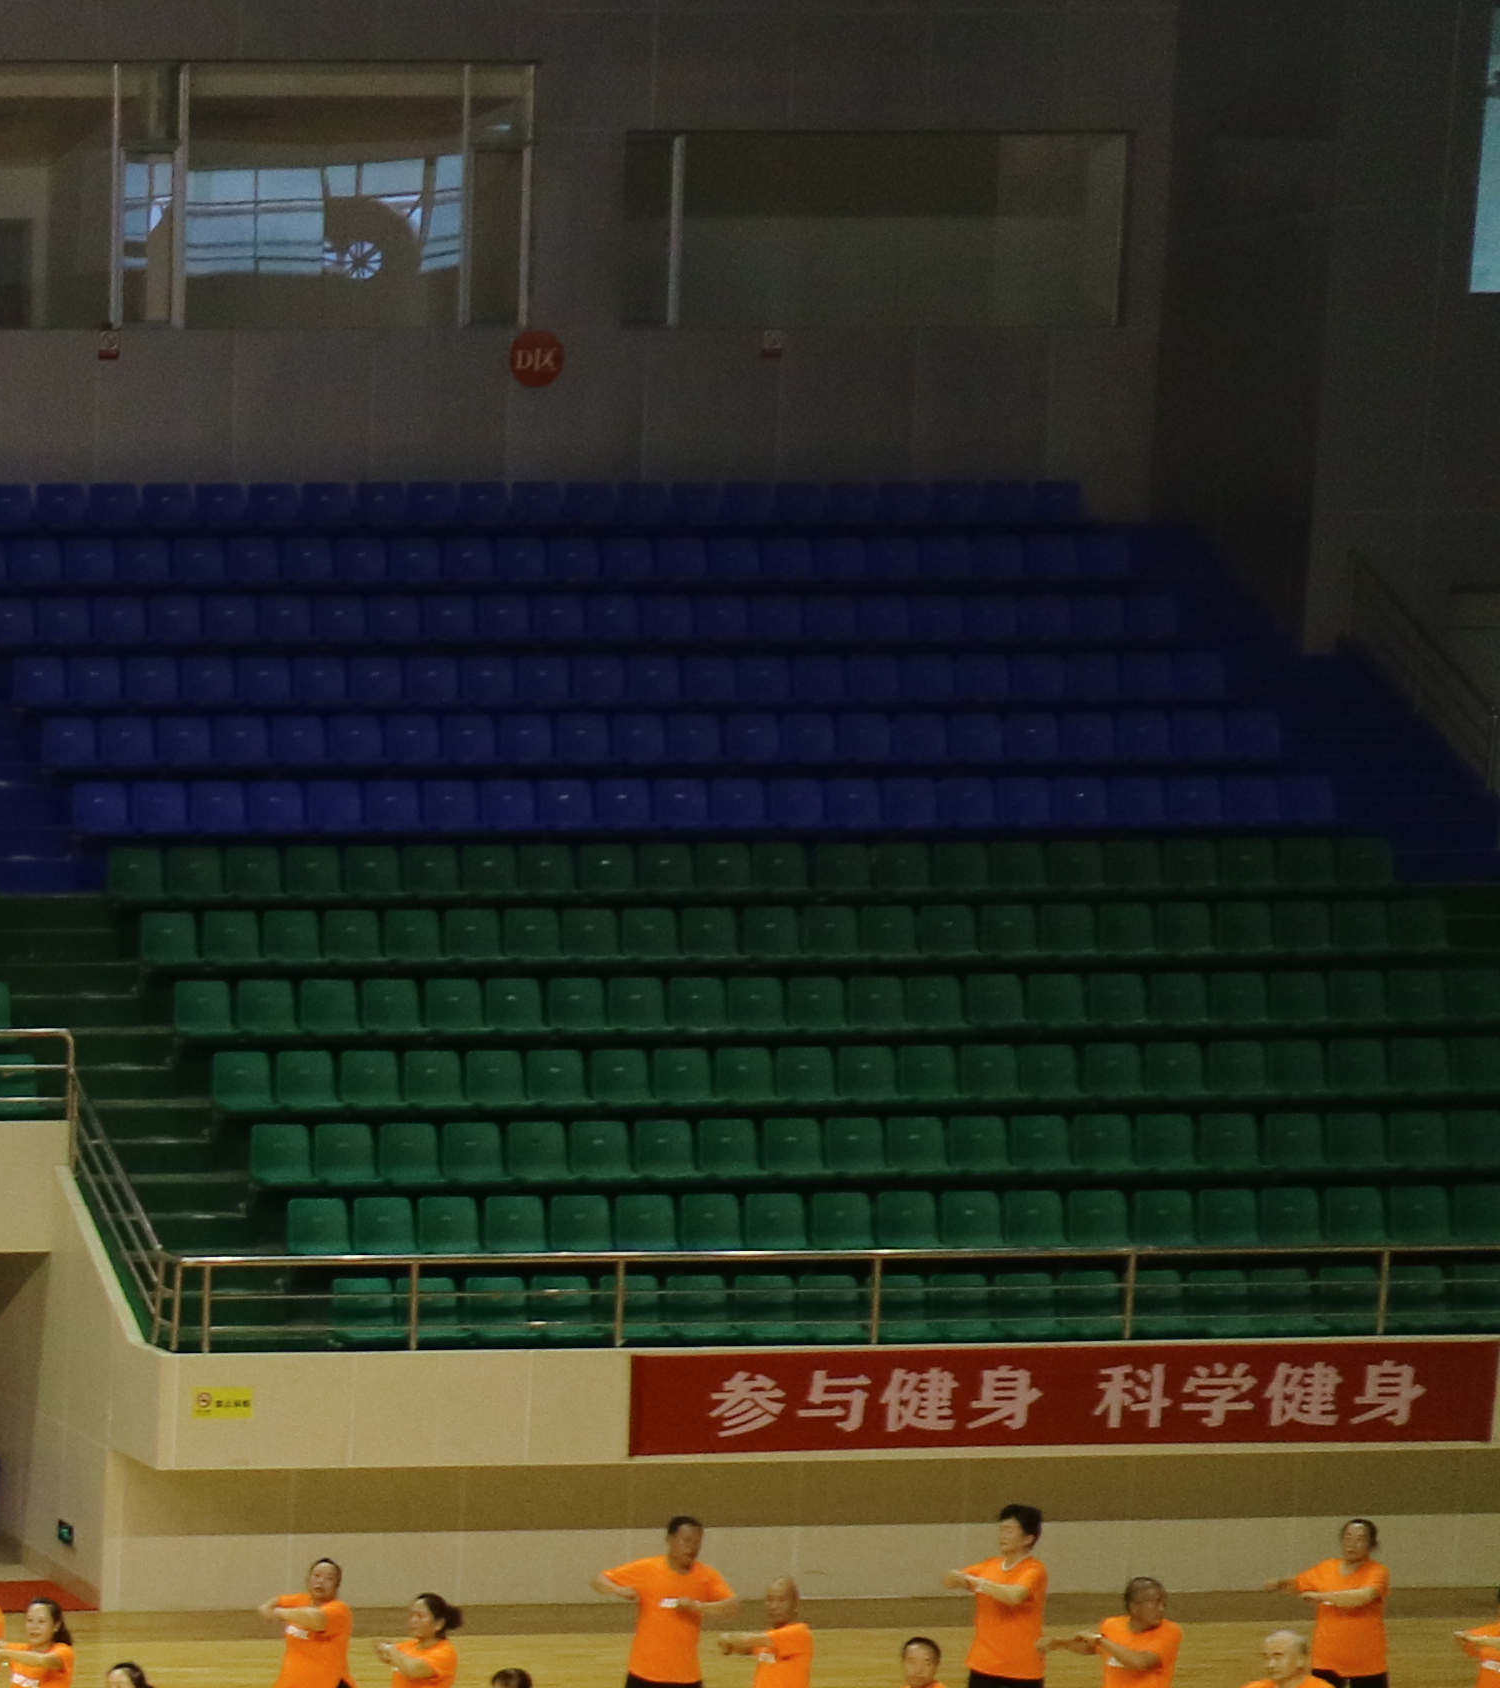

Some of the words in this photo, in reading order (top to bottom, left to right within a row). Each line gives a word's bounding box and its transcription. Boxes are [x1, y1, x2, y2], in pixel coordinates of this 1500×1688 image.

[709, 1364, 1043, 1436] 参与健身
[1095, 1358, 1428, 1430] 科学健身
